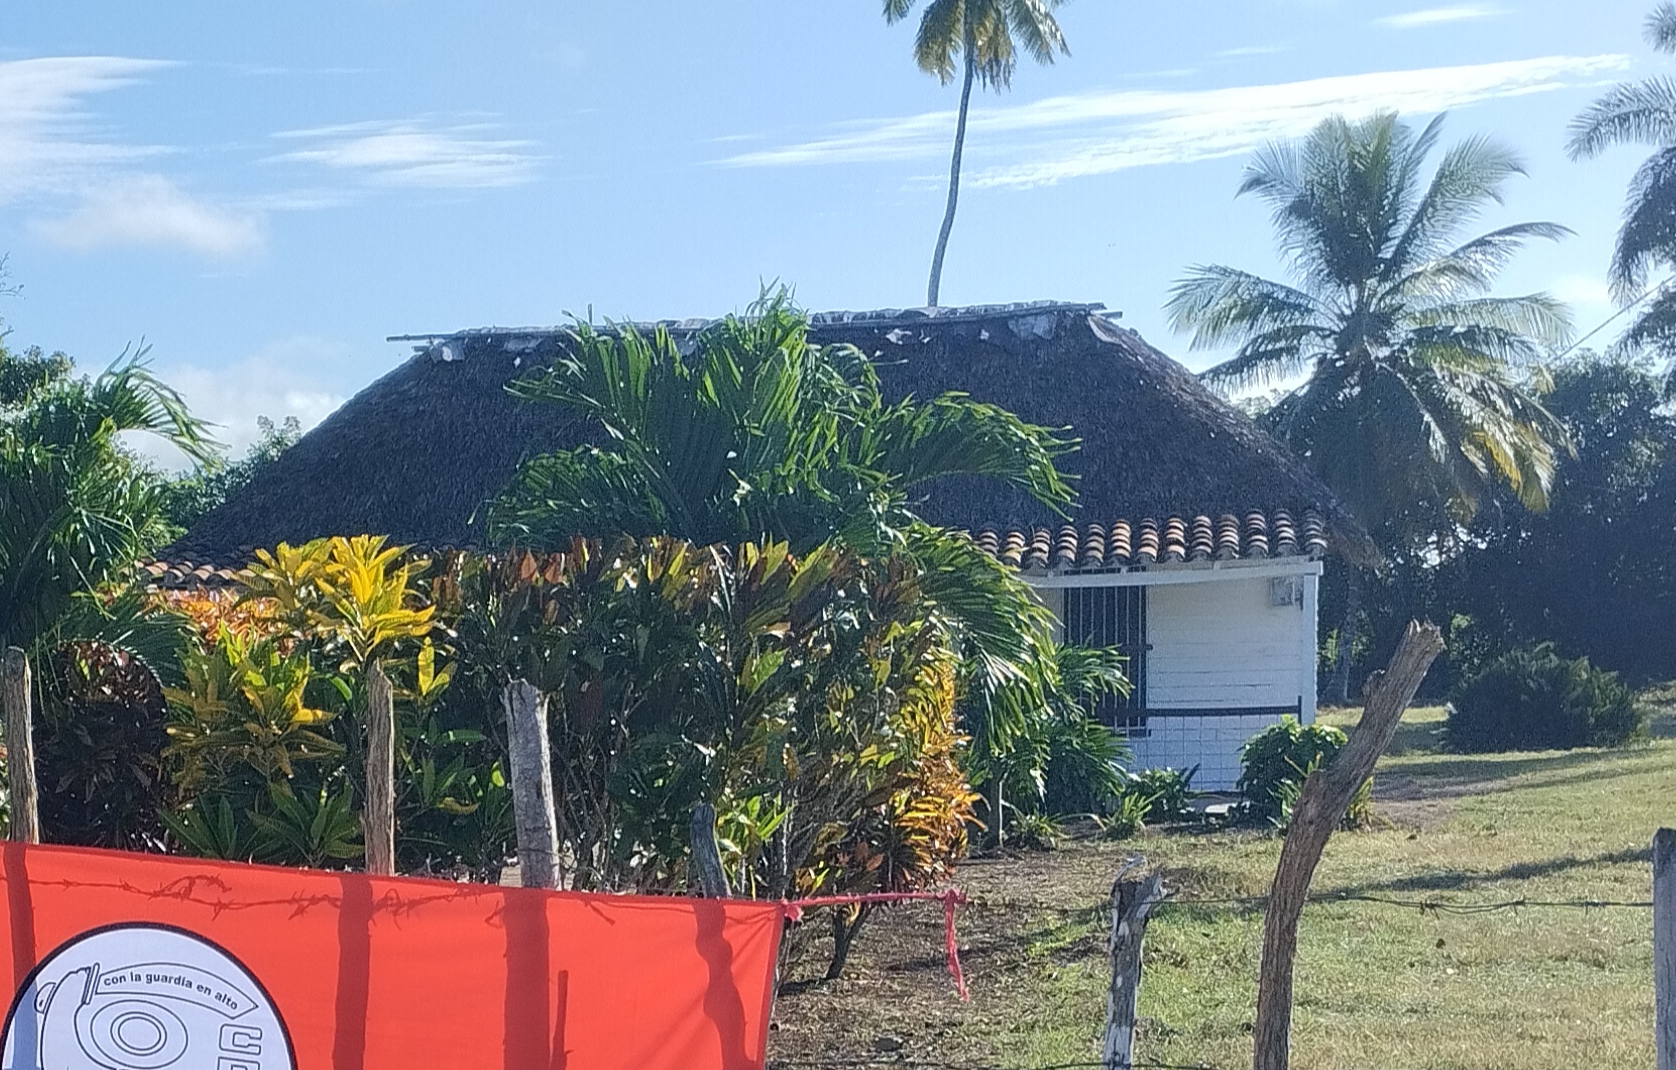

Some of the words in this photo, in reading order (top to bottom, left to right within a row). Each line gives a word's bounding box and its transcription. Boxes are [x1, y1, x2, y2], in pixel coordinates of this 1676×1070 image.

[103, 975, 127, 987] con
[130, 971, 142, 982] la
[145, 973, 193, 989] guardia
[196, 983, 212, 996] en
[214, 992, 239, 1010] alto
